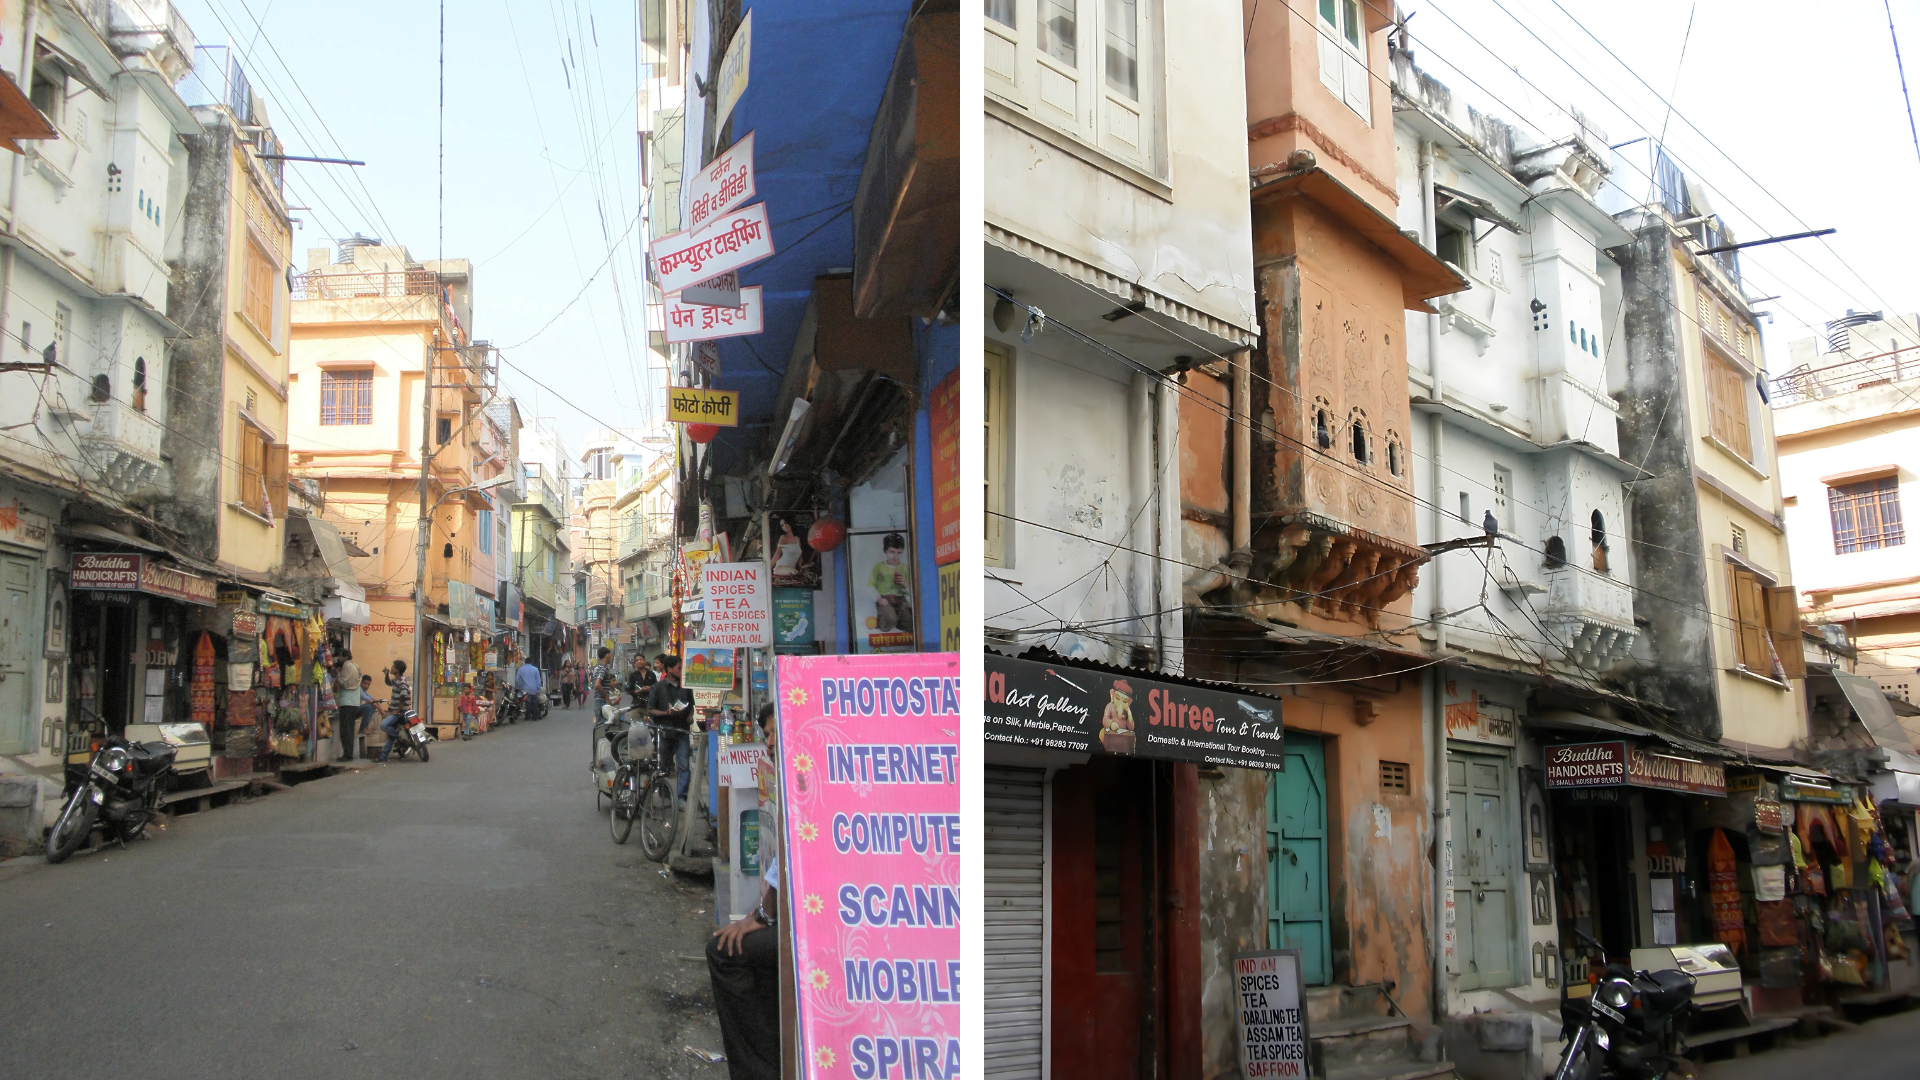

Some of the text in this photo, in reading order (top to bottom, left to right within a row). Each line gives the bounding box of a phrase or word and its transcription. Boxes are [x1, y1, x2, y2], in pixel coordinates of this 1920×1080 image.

[710, 156, 732, 182] प्लेन
[691, 193, 710, 226] सिडी
[711, 194, 718, 211] व
[658, 218, 762, 275] कम्प्युटर टाइपिंग
[670, 303, 749, 330] पेन ड्राइव
[673, 393, 732, 416] फोटो कोपी
[78, 555, 131, 569] Buddha
[72, 570, 138, 581] HANDICRAFTS
[141, 562, 183, 591] Buddha
[706, 569, 757, 582] INDIAN
[711, 584, 755, 595] SPICES
[712, 598, 750, 609] TEA
[709, 610, 766, 620] TEA SPICES
[363, 624, 385, 636] कृष्ण
[711, 623, 759, 632] SAFFRON
[709, 634, 763, 644] NATURAL OIL
[1005, 688, 1035, 708] Art
[1037, 694, 1090, 725] Gallery
[1148, 688, 1282, 741] Shree Tour & Travels
[992, 716, 1003, 724] on
[1005, 716, 1022, 728] Silk,
[984, 732, 1013, 743] Contact
[1013, 734, 1029, 744] No.:
[1030, 737, 1043, 746] +91
[1068, 740, 1088, 751] 77097
[1148, 734, 1180, 747] Domestic
[1187, 739, 1226, 752] International
[1227, 742, 1241, 753] Tour
[1204, 755, 1225, 764] Contact
[1553, 746, 1614, 763] Buddha
[826, 743, 958, 785] INTERNET
[1548, 763, 1623, 778] HANDICRAFTS
[1628, 749, 1680, 781] Buddha
[1682, 762, 1725, 788] HANDICRAFTS
[1572, 789, 1618, 801] (NO PAIN)
[832, 811, 960, 855] COMPUTE
[838, 883, 960, 929] SCANN
[1240, 975, 1280, 992] SPICES
[1242, 993, 1268, 1008] TEA
[1243, 1008, 1301, 1026] DARJLING TEA
[1247, 1026, 1303, 1043] ASSAM TEA
[1247, 1044, 1304, 1061] TEA SPICES
[1248, 1062, 1300, 1078] SAFFRON
